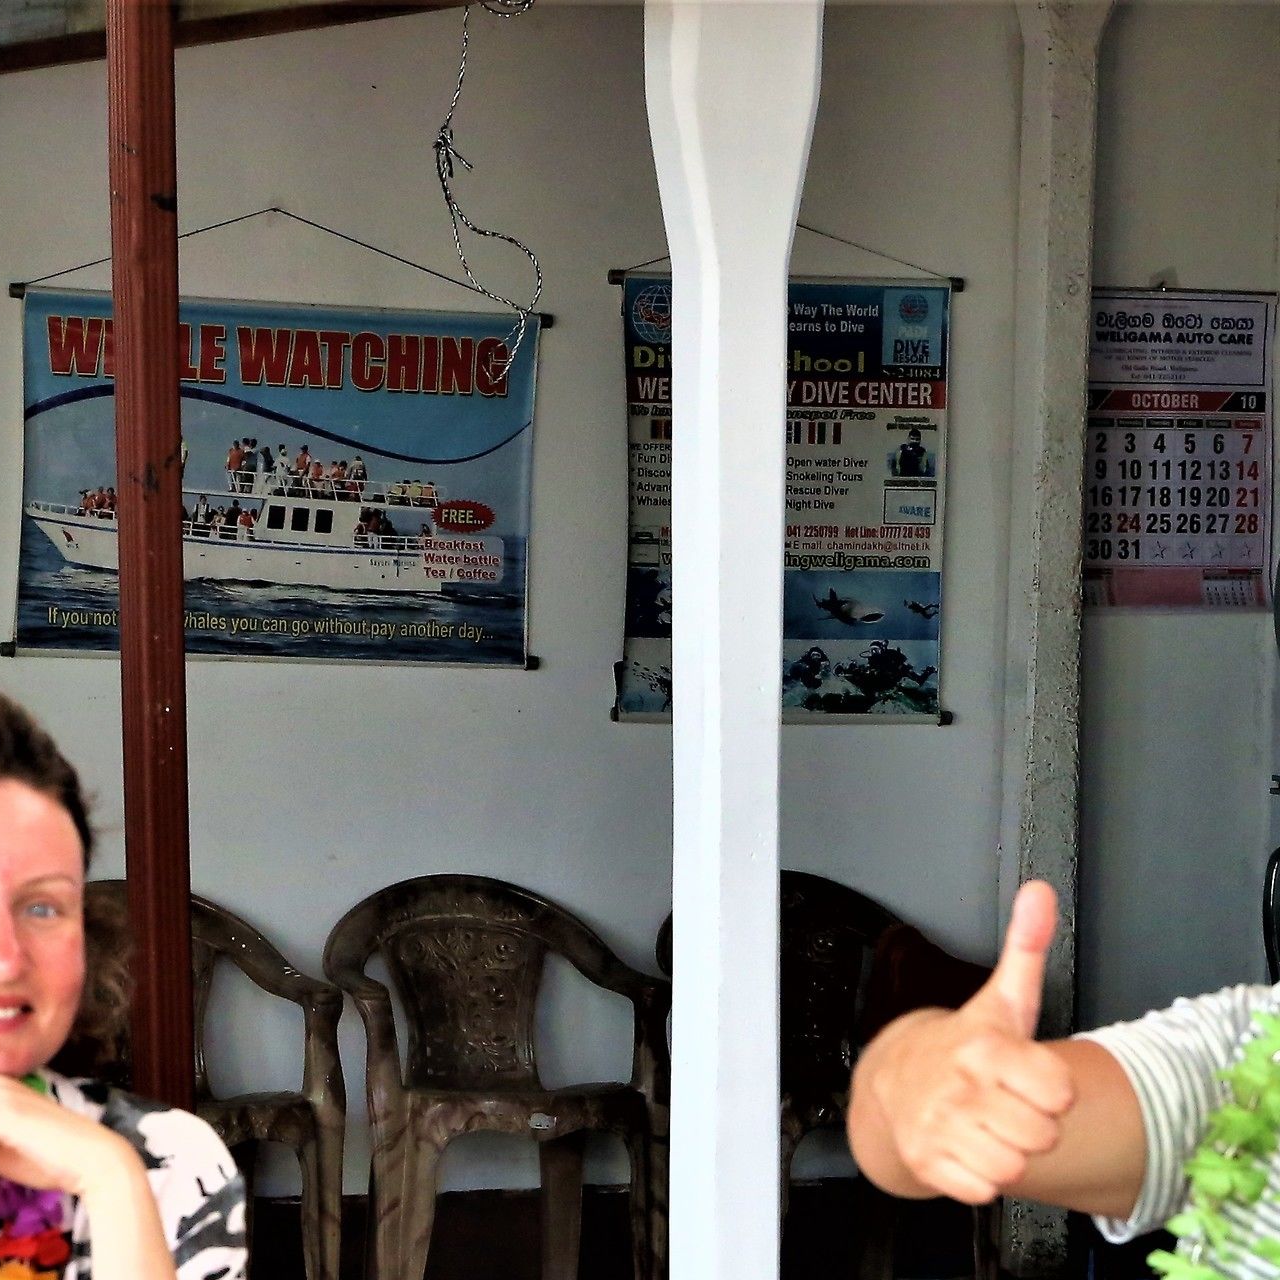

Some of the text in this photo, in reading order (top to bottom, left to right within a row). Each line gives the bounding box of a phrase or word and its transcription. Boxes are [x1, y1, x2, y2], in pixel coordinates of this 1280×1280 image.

[794, 303, 879, 318] Way The World
[788, 320, 865, 333] earns to Dive
[1096, 331, 1253, 345] WELIGAMA AUTO CARE
[893, 339, 929, 355] DIVE
[47, 315, 509, 396] WLE WATCHING
[633, 345, 865, 373] Di hool
[892, 353, 929, 364] RESORT
[802, 381, 849, 404] DIVE
[854, 382, 932, 405] CENTER
[1131, 393, 1257, 409] OCTOBER 10
[1095, 432, 1254, 454] 2 3 4 5 6 7
[786, 456, 868, 469] Open water Diver
[1095, 459, 1259, 480] 9 10 11 12 13 14
[637, 467, 672, 478] Discov
[786, 471, 863, 483] Snokeling Tours
[637, 482, 672, 492] Advan
[786, 485, 849, 496] Rescue Diver
[1089, 486, 1259, 507] 16 17 18 19 20 21
[785, 499, 835, 512] Night Dive
[1088, 512, 1259, 534] 23 24 25 26 27 28
[424, 538, 484, 551] Breakfast
[1088, 539, 1140, 560] 30 31
[423, 552, 459, 565] Water
[463, 554, 500, 566] bottle
[784, 551, 931, 570] ingweligama.com
[423, 566, 446, 579] Tea
[456, 567, 497, 581] Coffee
[48, 606, 58, 624] If
[61, 611, 89, 629] you
[92, 610, 117, 627] not
[231, 616, 257, 634] you
[262, 618, 287, 632] can
[291, 619, 310, 637] go
[313, 617, 367, 635] without
[370, 621, 396, 640] pay
[400, 621, 455, 638] another
